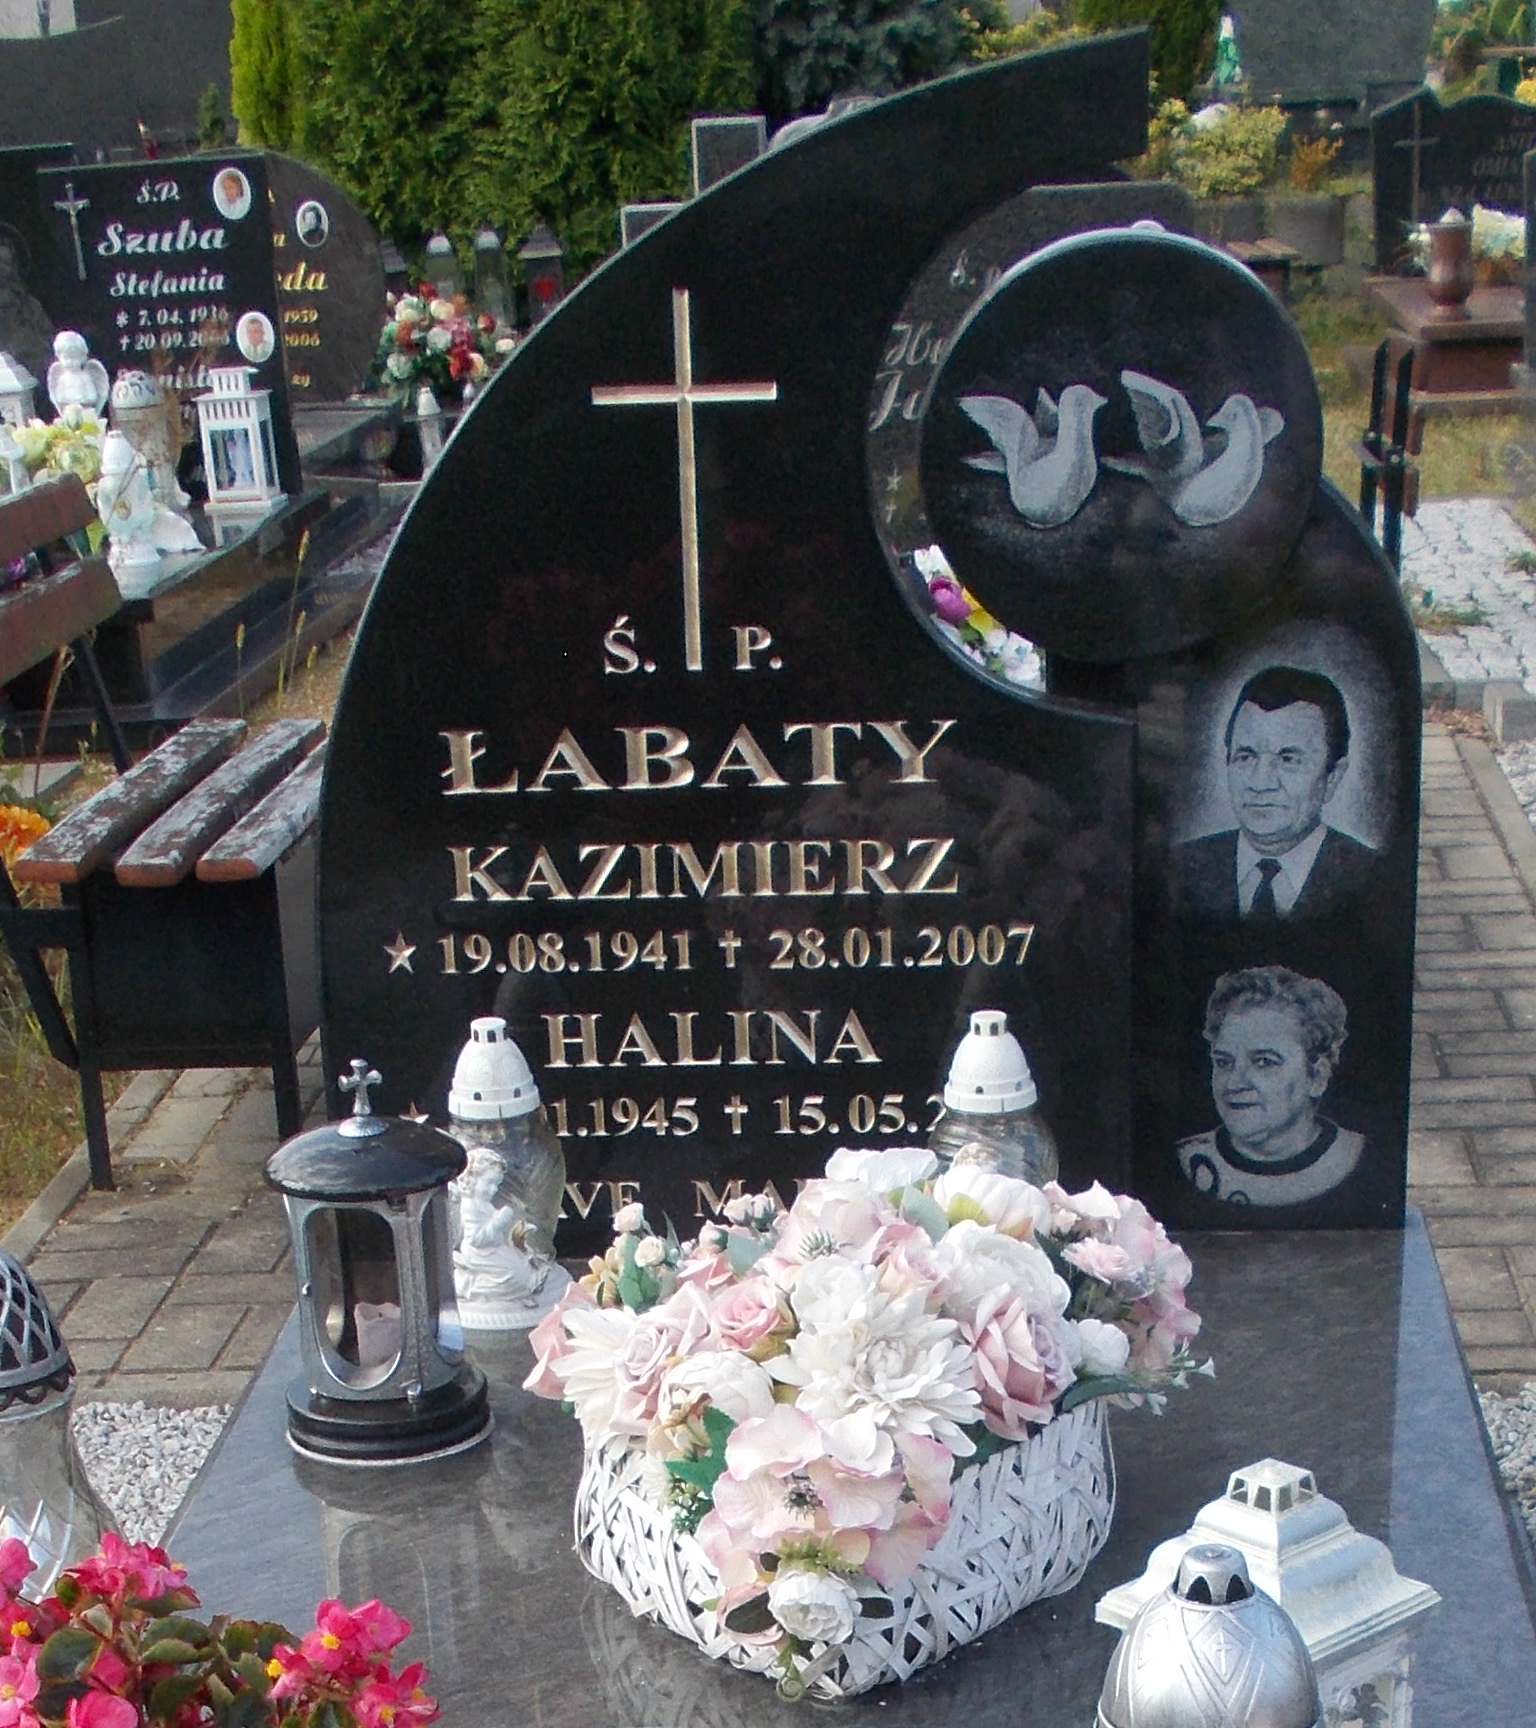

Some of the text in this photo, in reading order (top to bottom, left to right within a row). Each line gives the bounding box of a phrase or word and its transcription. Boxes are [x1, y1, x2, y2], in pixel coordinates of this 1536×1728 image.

[97, 219, 230, 256] Szuba
[110, 267, 226, 298] Stefania
[604, 615, 784, 675] Ś. P.
[438, 718, 958, 797] ŁABATY
[447, 837, 960, 903] KAZIMIERZ
[439, 923, 1036, 975] 19.08.1941 28.01.2007
[542, 1008, 883, 1070] HALINA
[544, 1093, 947, 1137] 1.1945 15.05.2
